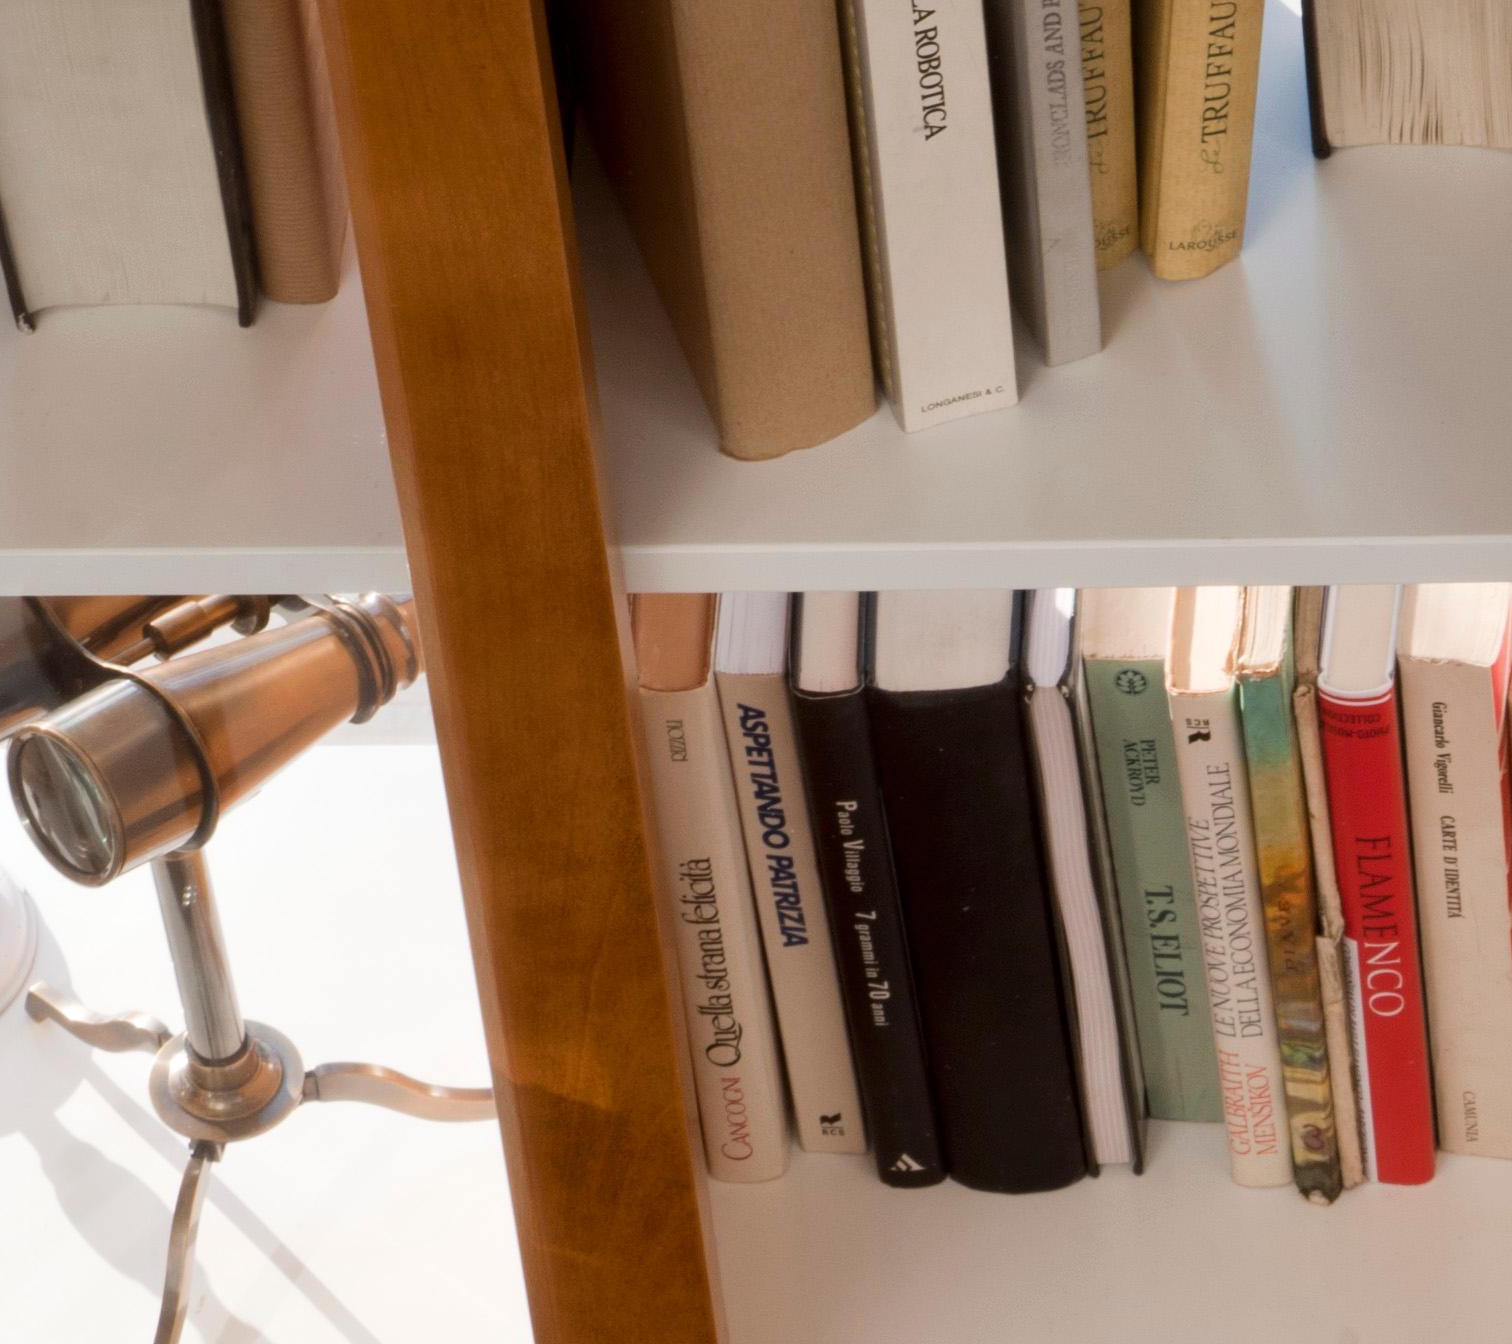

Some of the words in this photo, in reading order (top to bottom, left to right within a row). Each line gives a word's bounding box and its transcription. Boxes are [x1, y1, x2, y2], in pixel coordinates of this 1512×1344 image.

[1042, 18, 1066, 57] AND
[914, 26, 949, 142] ROBOTICA
[1168, 229, 1238, 253] LAROUSSE
[920, 390, 983, 414] LONGANESI
[670, 718, 689, 763] RIZZOLI
[1431, 700, 1449, 749] Giancarlo
[1140, 737, 1161, 786] PETER
[1436, 751, 1455, 795] Vigorelli
[737, 703, 792, 849] ASPETTANDO
[766, 853, 810, 949] PATRIZIA
[835, 800, 858, 837] Paolo
[1207, 761, 1244, 870] MONDIALE
[1440, 814, 1459, 853] CARTE
[840, 839, 866, 895] Villaggio
[1189, 817, 1226, 948] PROSPETTIVE
[855, 910, 878, 921] 7
[1144, 885, 1178, 933] T.S.
[1222, 869, 1256, 980] ECONOMIA
[1354, 836, 1406, 1018] FLAMENCO
[696, 928, 728, 992] strana
[854, 922, 875, 968] grammi
[867, 980, 891, 1001] 70
[1150, 931, 1189, 1017] ELIOT
[1206, 947, 1232, 1018] NUOVE
[704, 992, 743, 1069] Quella
[873, 1001, 889, 1028] anni
[1215, 1020, 1238, 1039] LE
[1231, 979, 1263, 1039] DELLA
[1218, 1050, 1250, 1157] GALBRAITH
[1462, 1089, 1479, 1144] CAMUNIA
[821, 1126, 846, 1137] RCS
